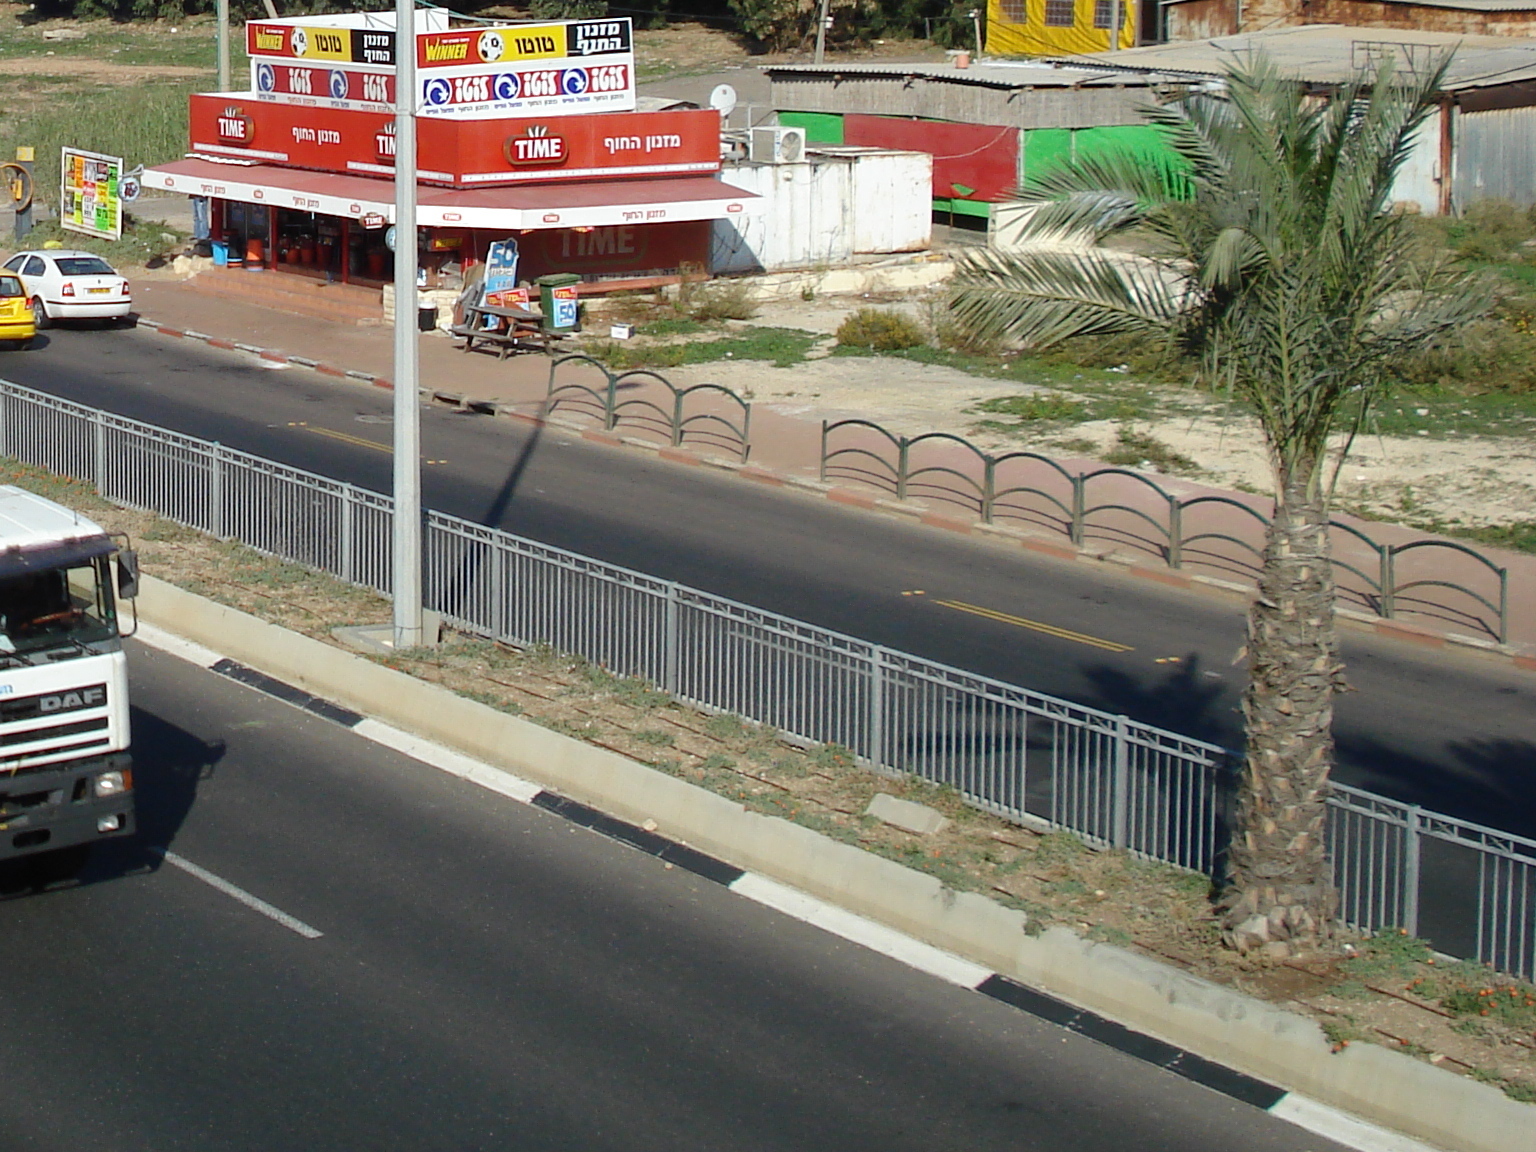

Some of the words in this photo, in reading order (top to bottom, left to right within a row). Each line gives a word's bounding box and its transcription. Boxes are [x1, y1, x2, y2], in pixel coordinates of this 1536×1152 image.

[576, 23, 620, 38] מזנון
[314, 34, 342, 53] טוטו
[363, 34, 389, 48] מזנון
[425, 36, 468, 62] WINNER
[515, 35, 556, 55] טוטו
[577, 36, 621, 55] החוף
[364, 49, 390, 63] החוף
[289, 68, 312, 94] לוטו
[363, 74, 388, 102] לוטו
[523, 70, 557, 98] לוטו
[592, 65, 625, 93] לוטו
[455, 76, 489, 104] לוטו
[218, 118, 245, 138] TIME
[292, 127, 316, 143] החוף
[317, 129, 341, 145] מזנון
[515, 138, 562, 159] TIME
[604, 136, 641, 154] החוף
[645, 134, 681, 153] מזנון
[560, 303, 575, 322] 50
[39, 688, 104, 712] DAF
